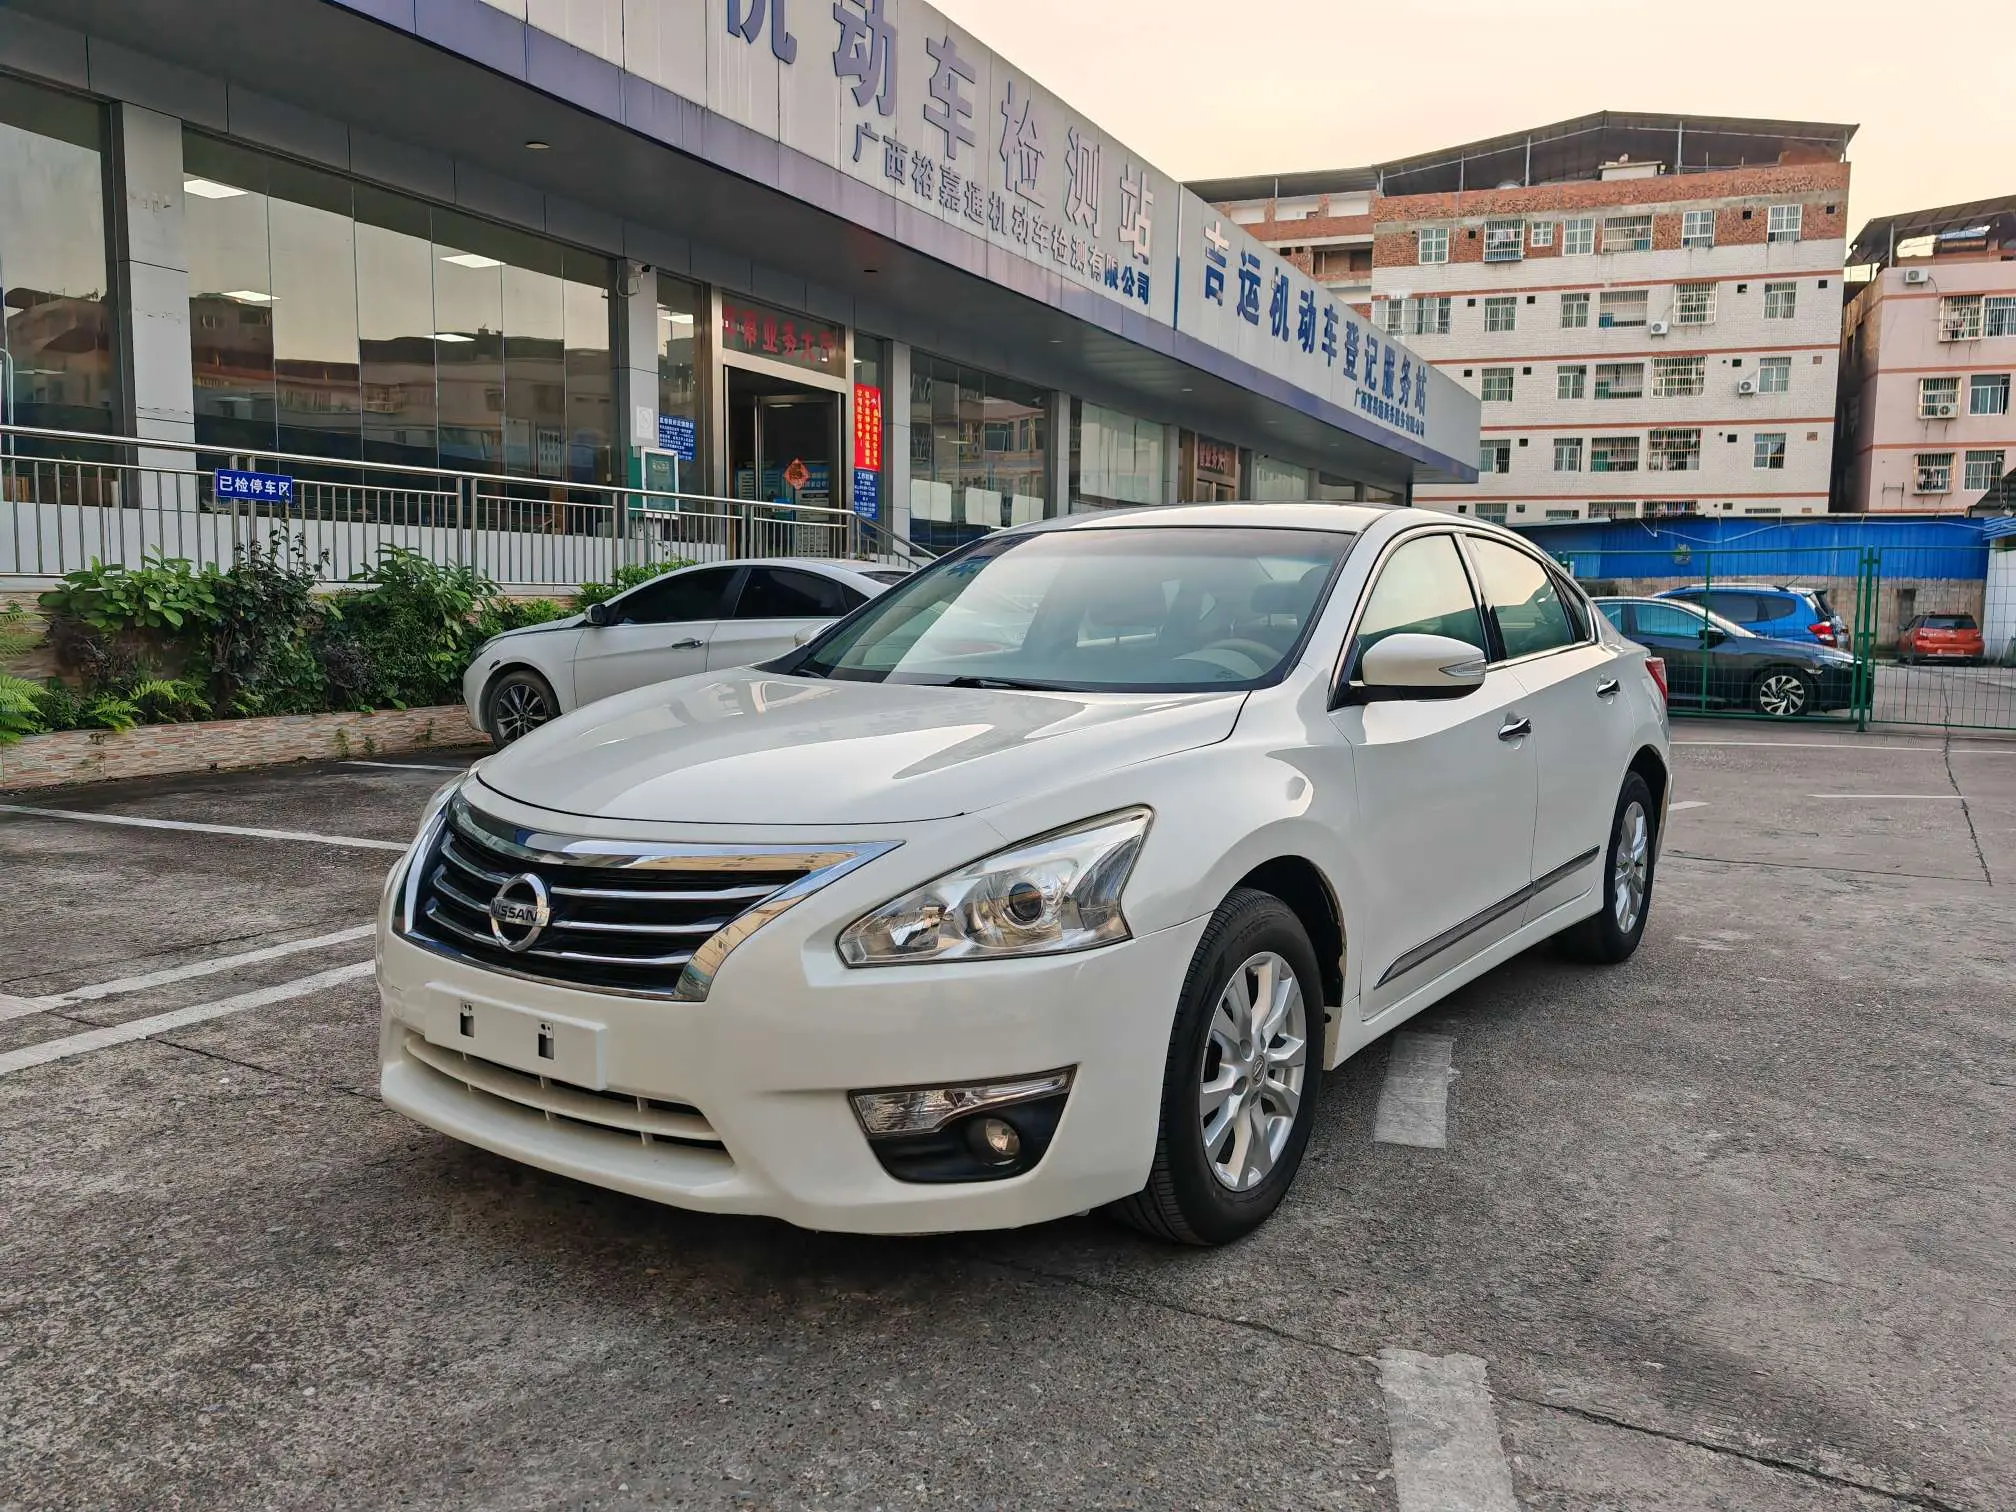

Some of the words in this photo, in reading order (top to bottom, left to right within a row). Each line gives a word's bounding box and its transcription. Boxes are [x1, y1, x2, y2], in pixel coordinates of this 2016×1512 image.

[852, 121, 1150, 305] 广西裕嘉通机动车检测有限公司
[1204, 220, 1427, 416] 吉运机动车登记服务站
[219, 475, 290, 497] 已检停车区
[491, 901, 537, 922] NISSAN
